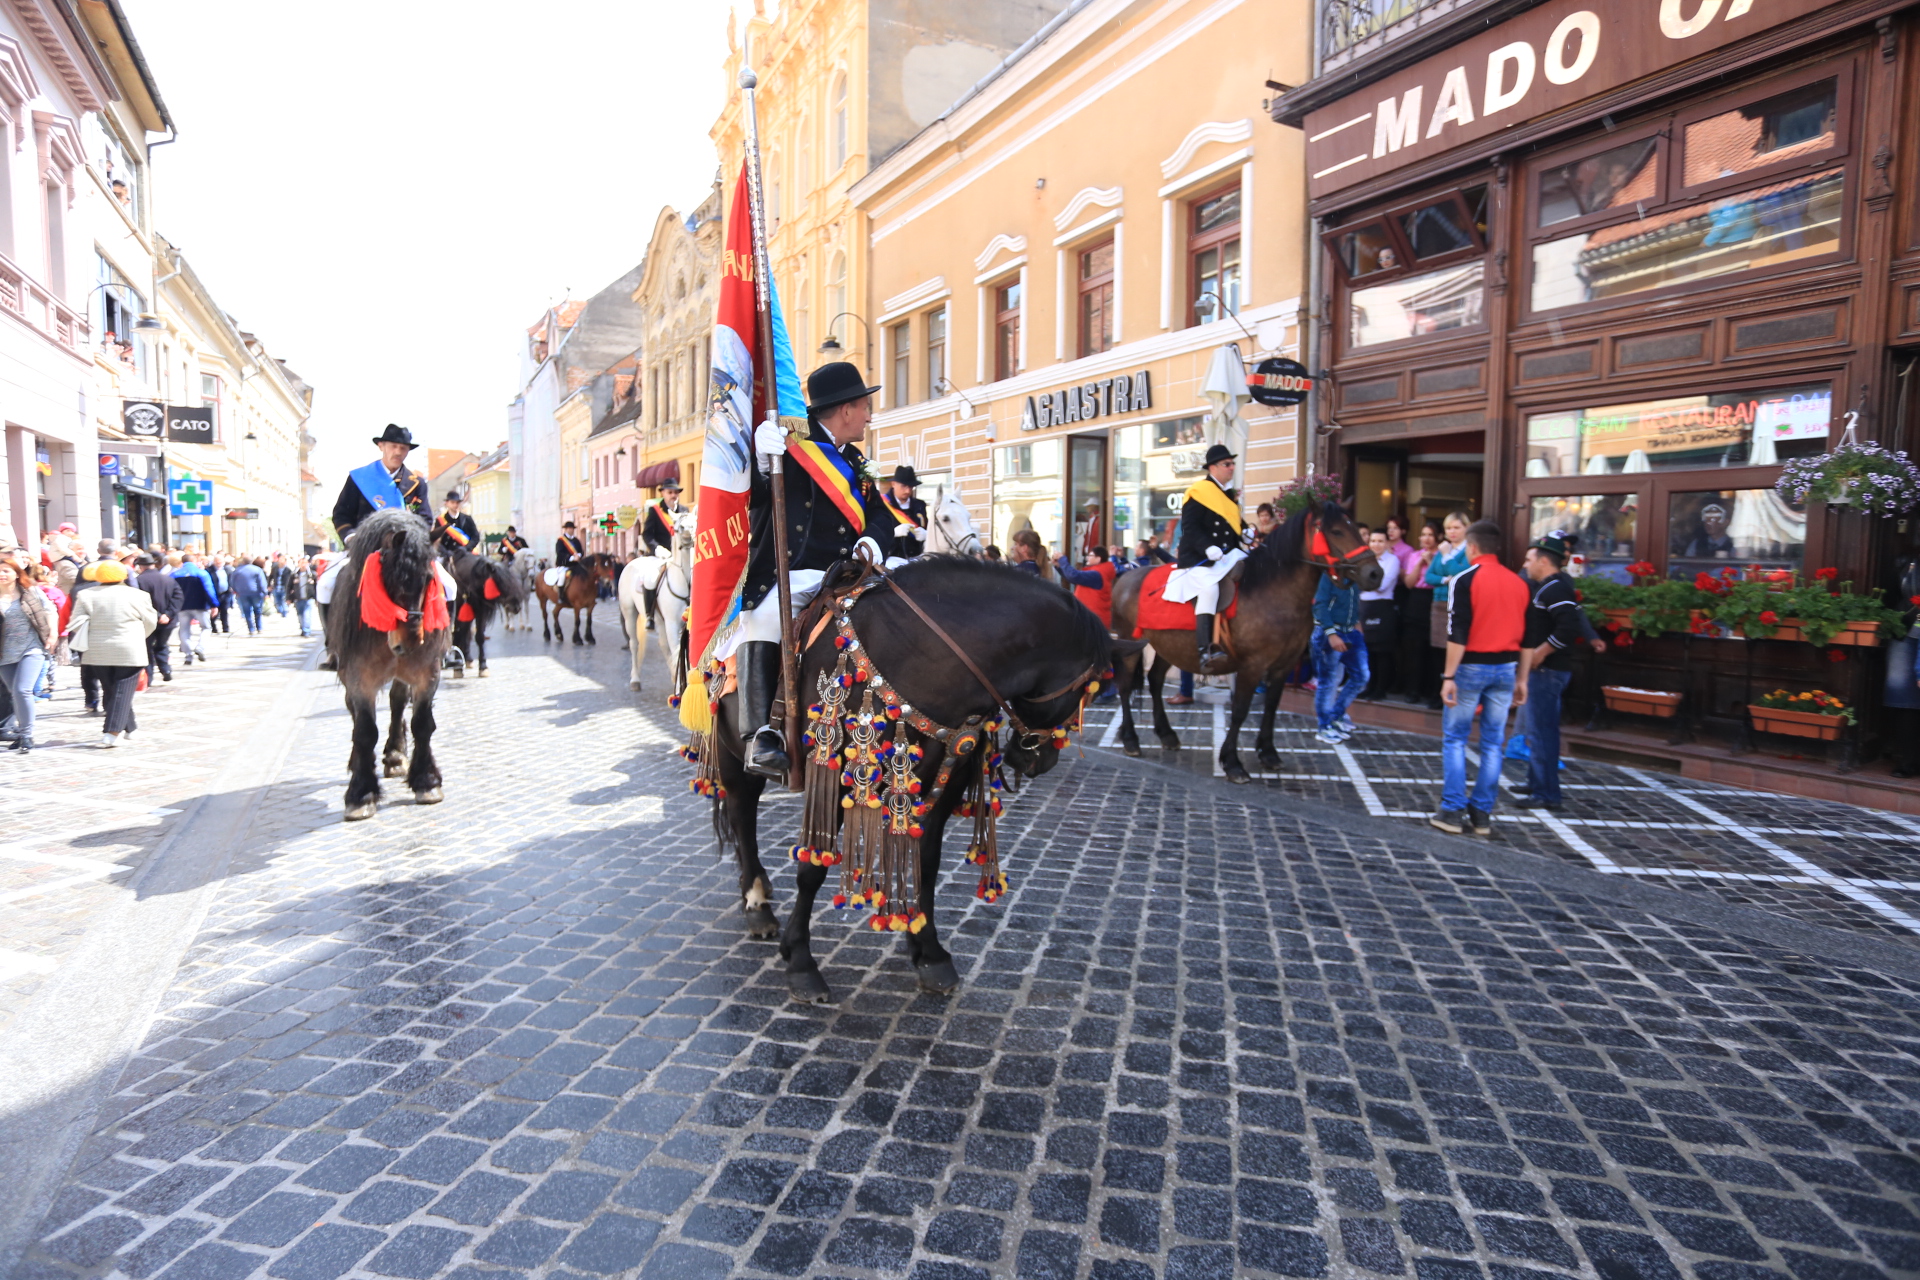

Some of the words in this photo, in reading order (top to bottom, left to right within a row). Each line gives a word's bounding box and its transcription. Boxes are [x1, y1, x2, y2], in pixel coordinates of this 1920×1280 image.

[1373, 10, 1600, 160] MADO
[1264, 373, 1304, 392] MADO
[170, 419, 210, 431] CATO
[1639, 398, 1786, 431] RESTAURANT
